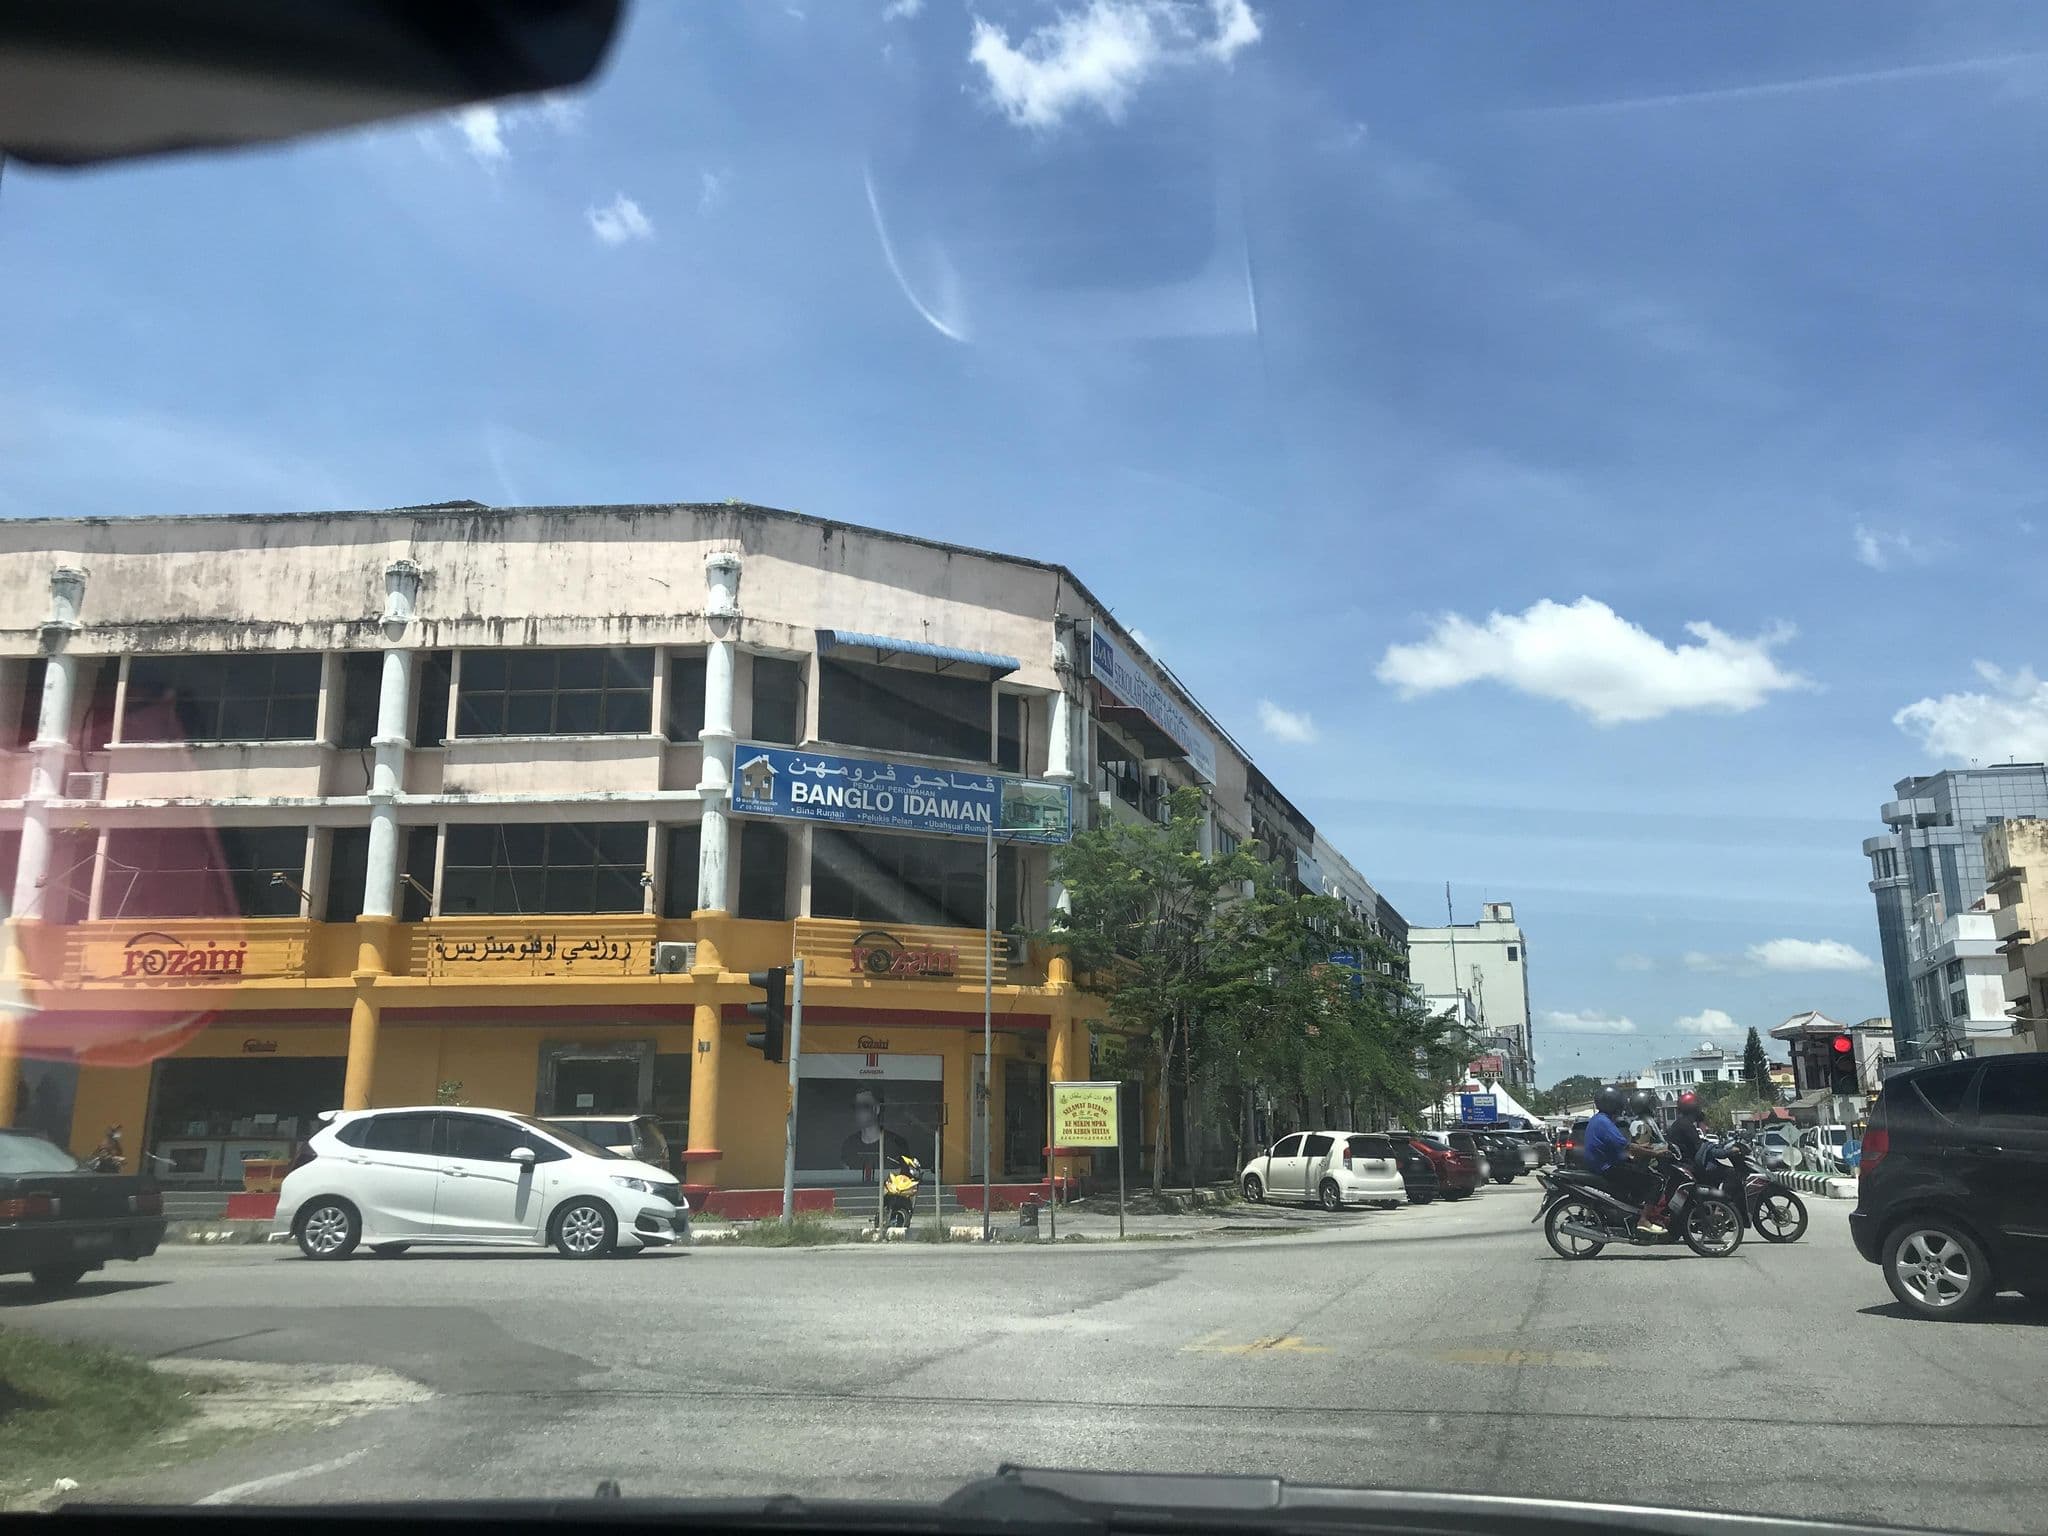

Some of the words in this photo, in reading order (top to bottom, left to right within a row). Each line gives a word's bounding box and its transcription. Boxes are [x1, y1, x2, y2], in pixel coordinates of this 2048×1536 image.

[853, 781, 885, 791] PEMAJU
[888, 786, 936, 797] PERUMAHAN
[791, 781, 893, 812] BANGLO
[903, 794, 992, 824] IDAMAN
[796, 806, 815, 816] Bina
[816, 808, 845, 819] Rumah
[1063, 1102, 1085, 1116] SELAMAT
[1087, 1102, 1109, 1116] DATANG
